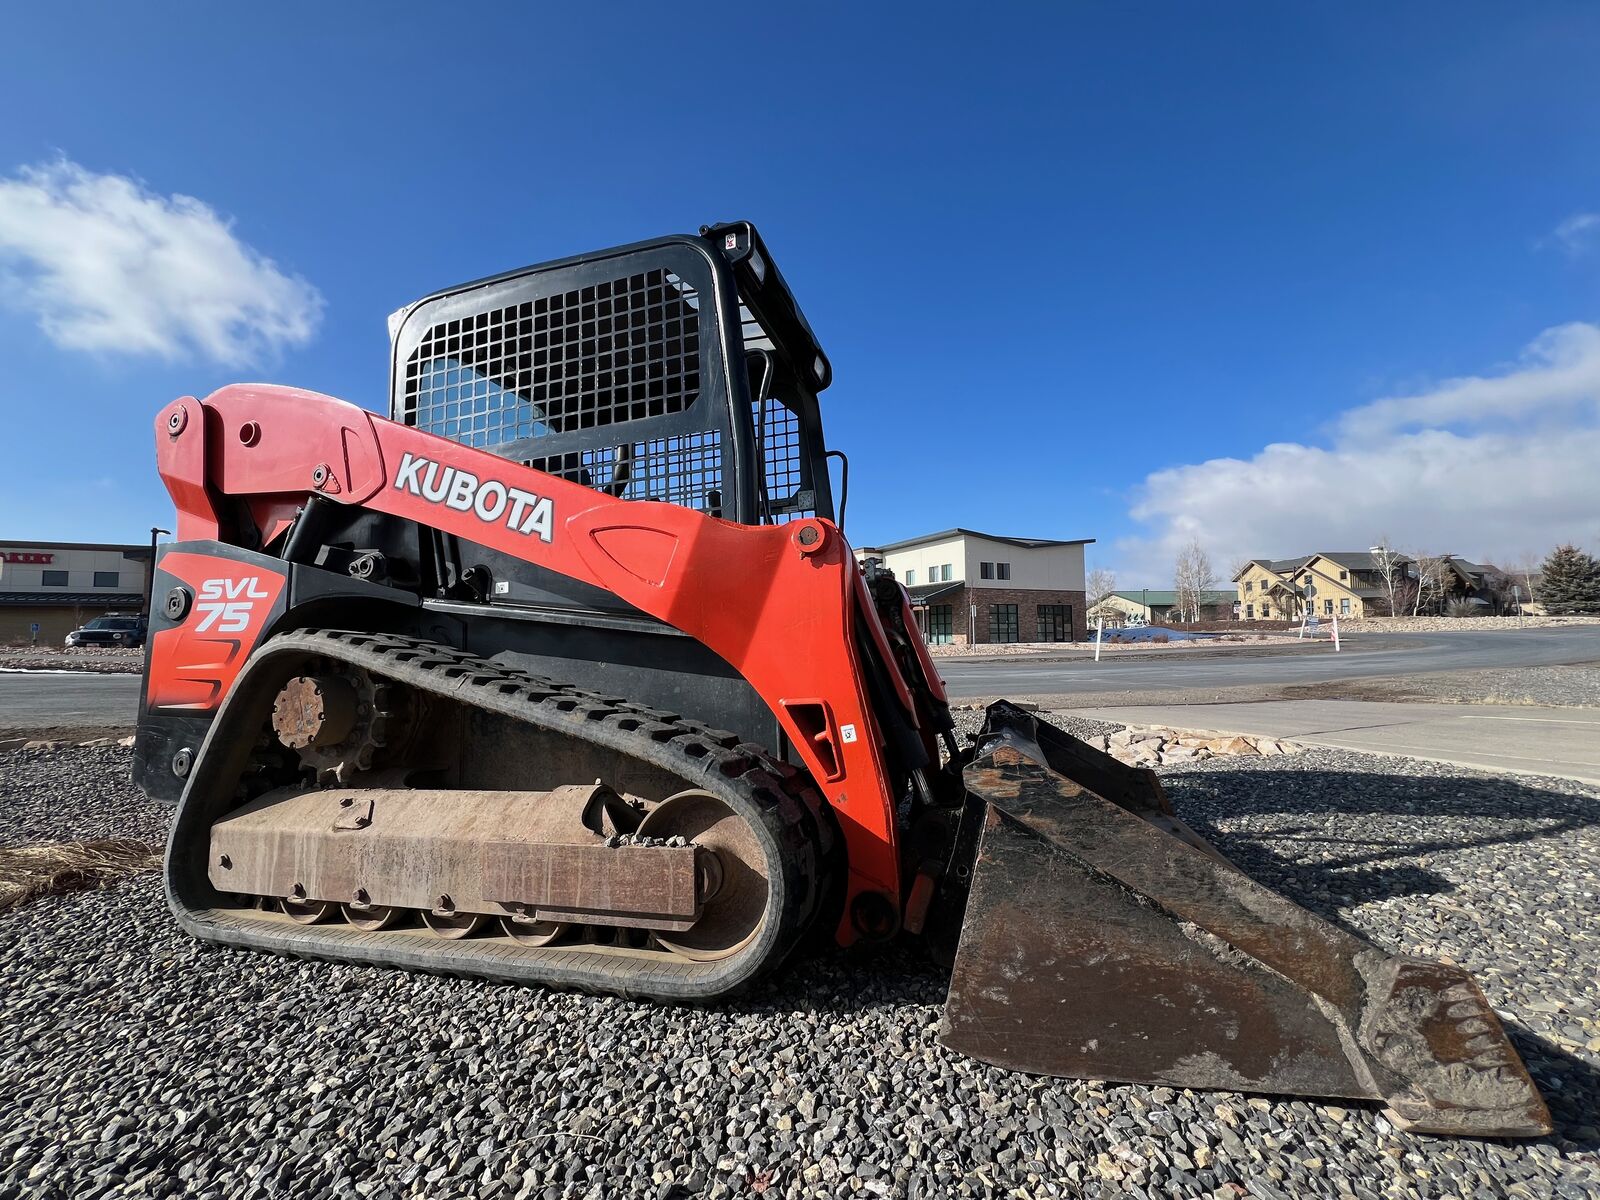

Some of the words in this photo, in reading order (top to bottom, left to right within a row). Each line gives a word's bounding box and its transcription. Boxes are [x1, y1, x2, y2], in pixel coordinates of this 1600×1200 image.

[394, 453, 554, 543] KUBOTA
[198, 577, 268, 600] SVL
[195, 602, 253, 632] 75
